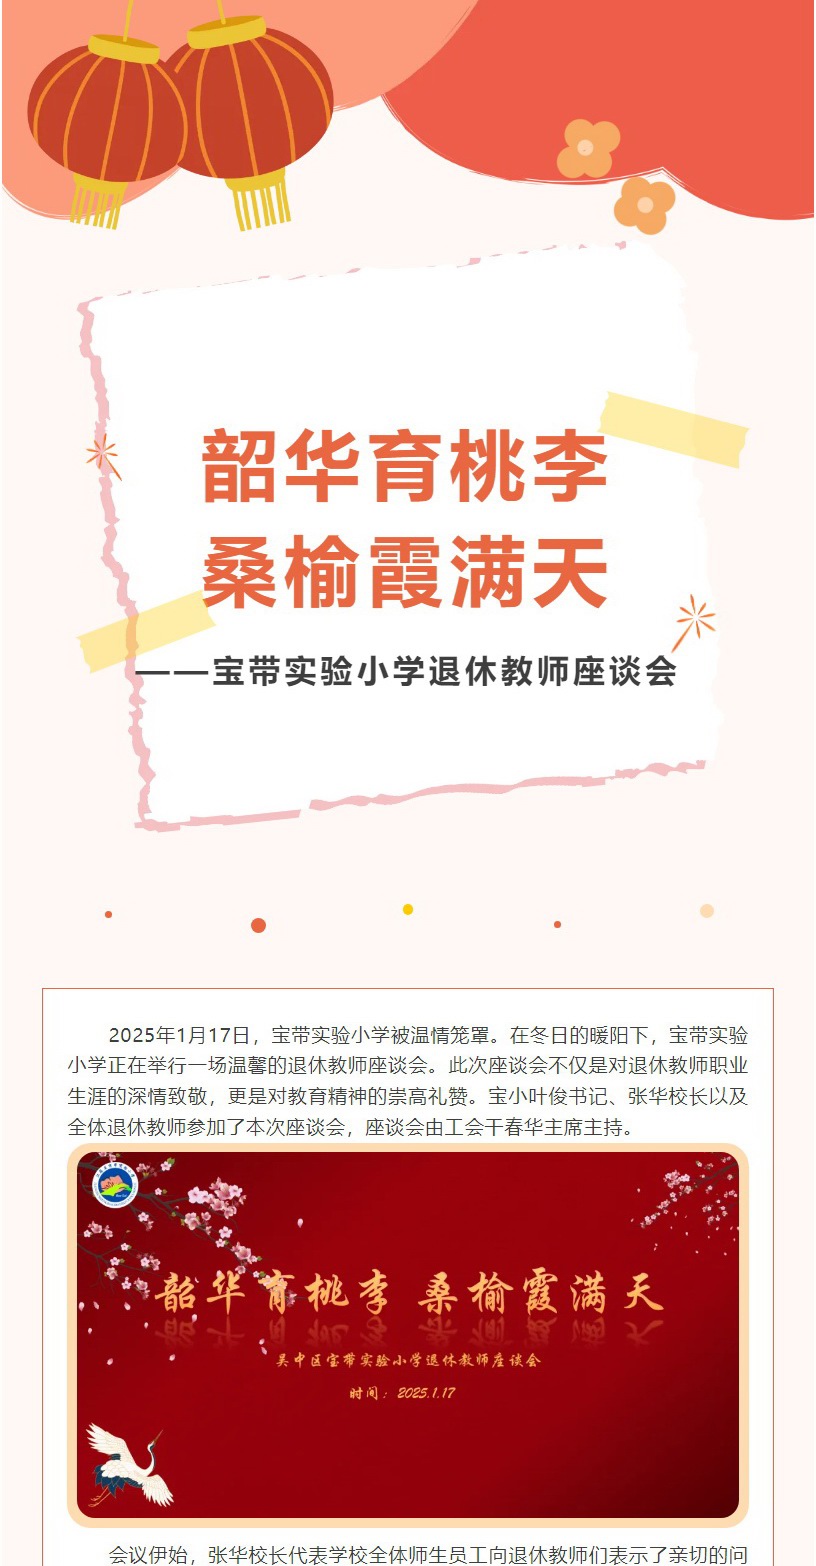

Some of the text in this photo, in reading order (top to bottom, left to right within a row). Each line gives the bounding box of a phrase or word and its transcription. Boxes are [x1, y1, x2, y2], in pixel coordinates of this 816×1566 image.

[109, 1024, 749, 1046] 2025年1月17日，宝带实验小学被温情笼罩。在冬日的暖阳下，宝带实验
[67, 1055, 749, 1075] 小学正在举行一场温馨的退休教师座谈会。此次座谈会不仅是对退休教师职业
[67, 1085, 749, 1107] 生涯的深情致敬，更是对教育精神的崇高礼赞。宝小叶俊书记、张华校长以及
[67, 1116, 634, 1138] 全体退休教师参加了本次座谈会，座谈会由工会干春华主席主持。
[154, 1268, 664, 1316] 韶华育桃李 桑榆霞满天
[276, 1351, 542, 1369] 吴中区宝带实验小学退休教师座谈会
[108, 1545, 748, 1566] 会议伊始，张华校长代表学校全体师生员工向退休教师们表示了亲切的问
